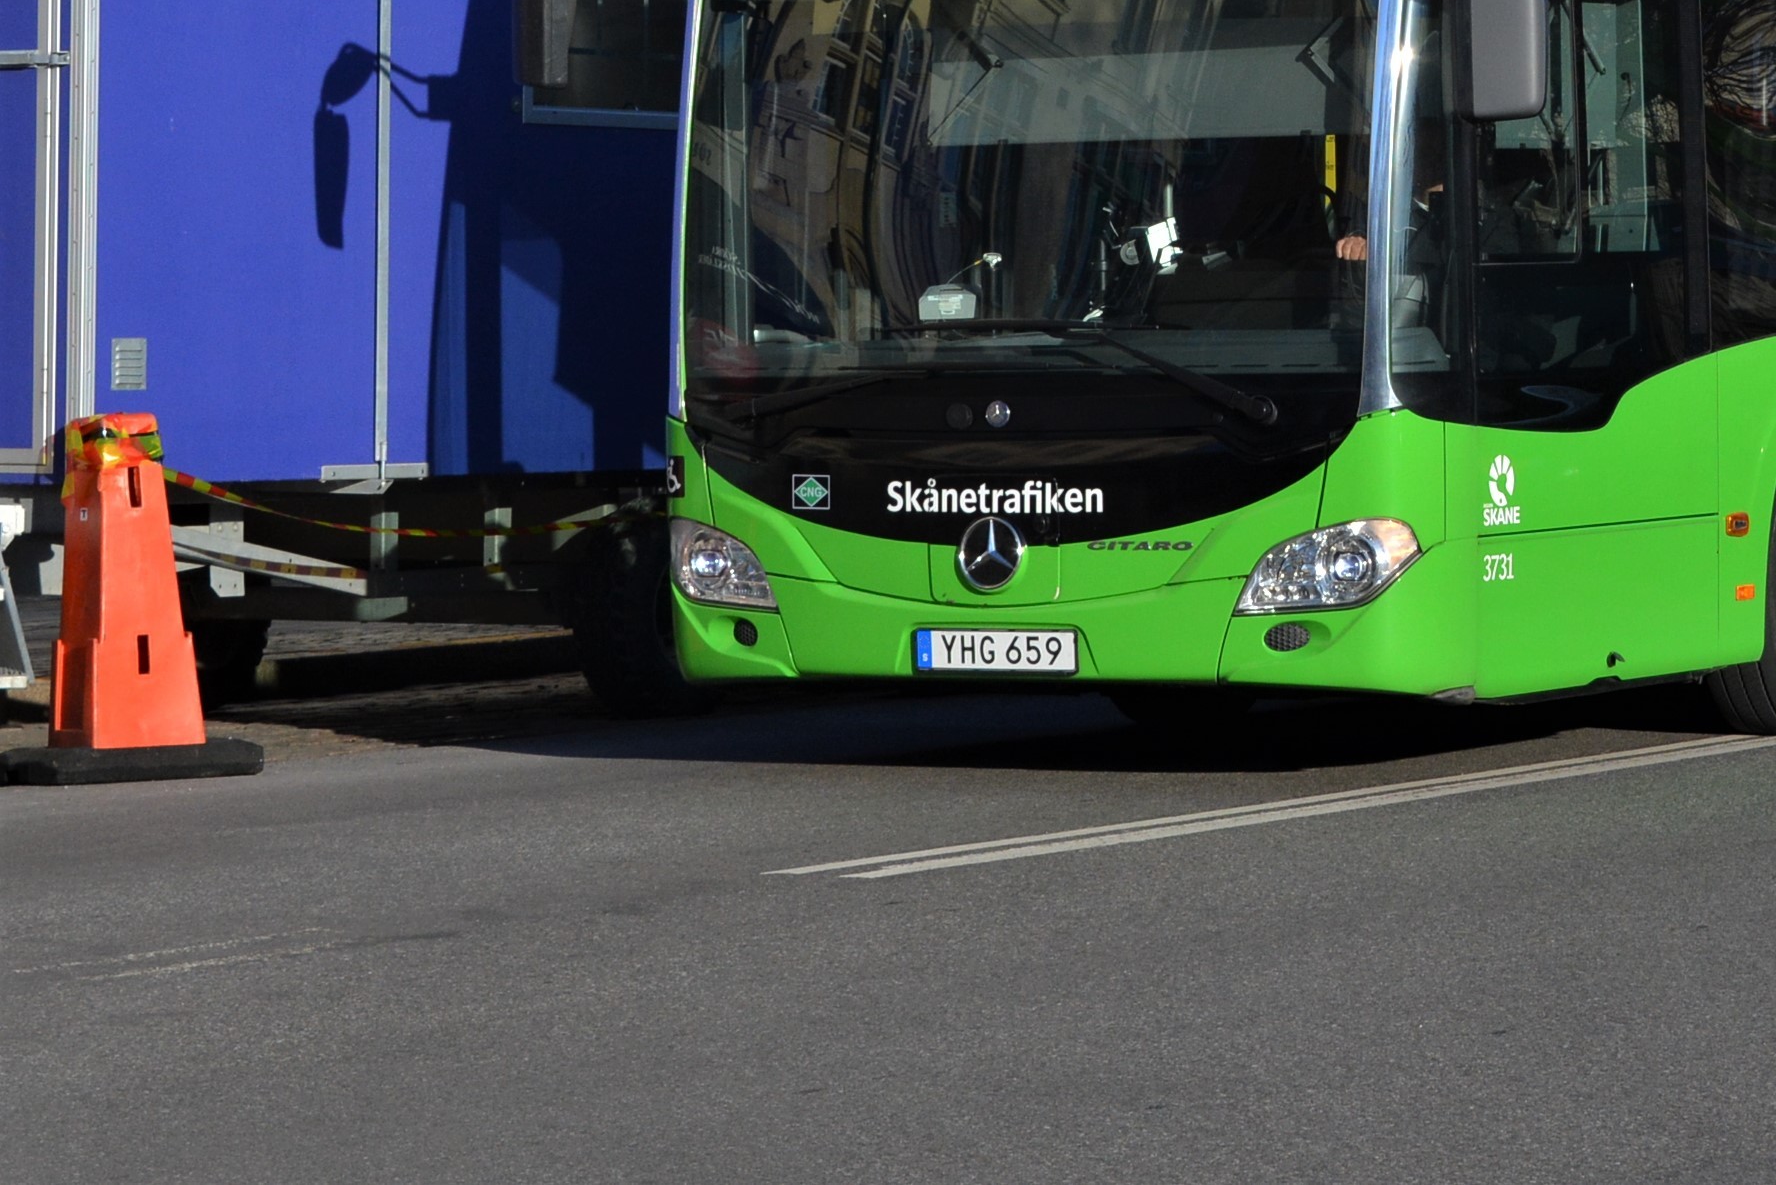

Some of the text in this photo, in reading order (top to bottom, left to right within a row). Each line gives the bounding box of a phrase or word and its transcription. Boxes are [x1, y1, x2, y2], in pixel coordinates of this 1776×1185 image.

[800, 487, 823, 498] CNG
[887, 477, 1105, 515] Skånetrafiken
[1087, 539, 1194, 551] CITARO
[1483, 552, 1514, 581] 3731
[941, 634, 1063, 665] YHG 659
